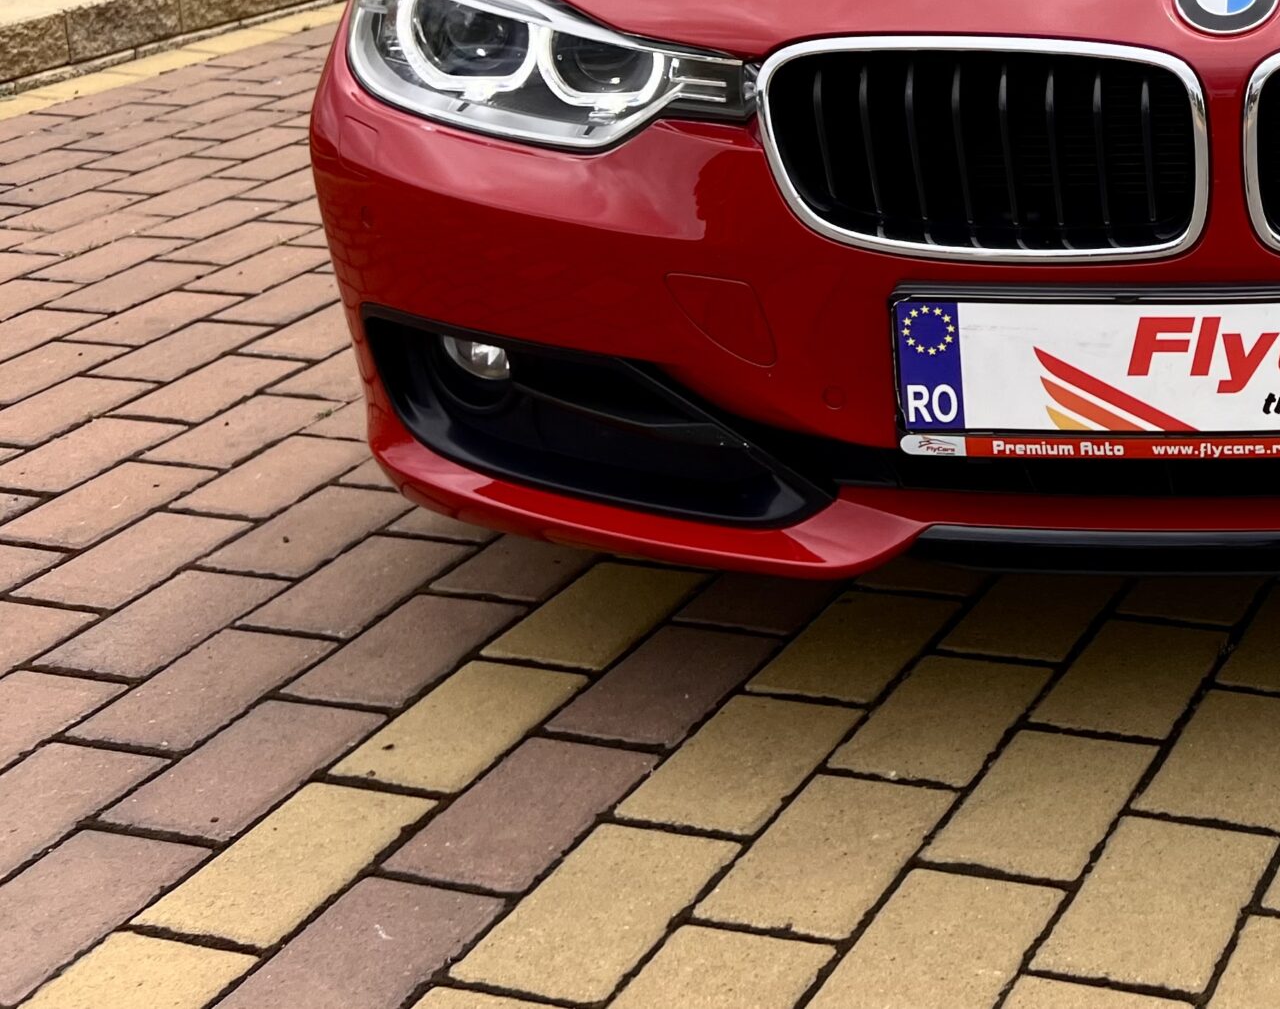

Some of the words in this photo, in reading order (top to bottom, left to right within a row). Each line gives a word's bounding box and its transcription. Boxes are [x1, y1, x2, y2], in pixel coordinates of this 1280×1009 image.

[907, 384, 958, 424] RO
[992, 440, 1074, 456] Premium
[1079, 441, 1125, 456] Auto
